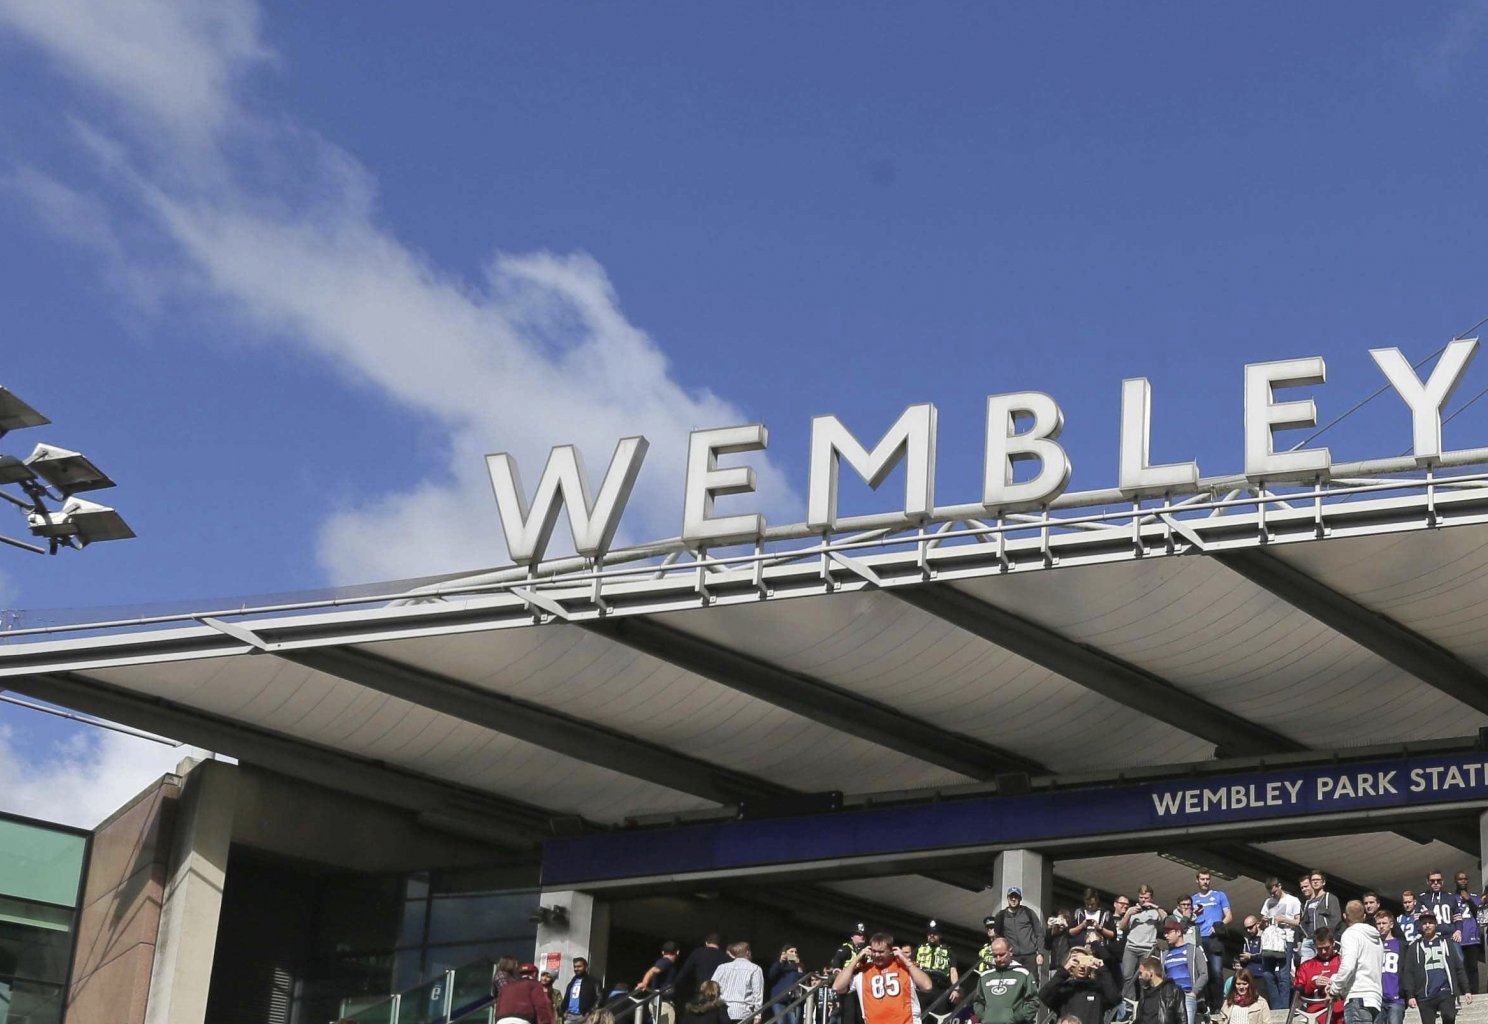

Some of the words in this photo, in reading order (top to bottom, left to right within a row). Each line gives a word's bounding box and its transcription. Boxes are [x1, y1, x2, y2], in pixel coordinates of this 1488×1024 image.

[485, 336, 1480, 566] WEMBLEY
[1152, 779, 1303, 816] WEMBLEY
[1317, 771, 1398, 801] PARK
[1433, 904, 1451, 925] 40
[1382, 952, 1399, 973] 8
[1425, 947, 1443, 970] 25
[871, 972, 900, 999] 85
